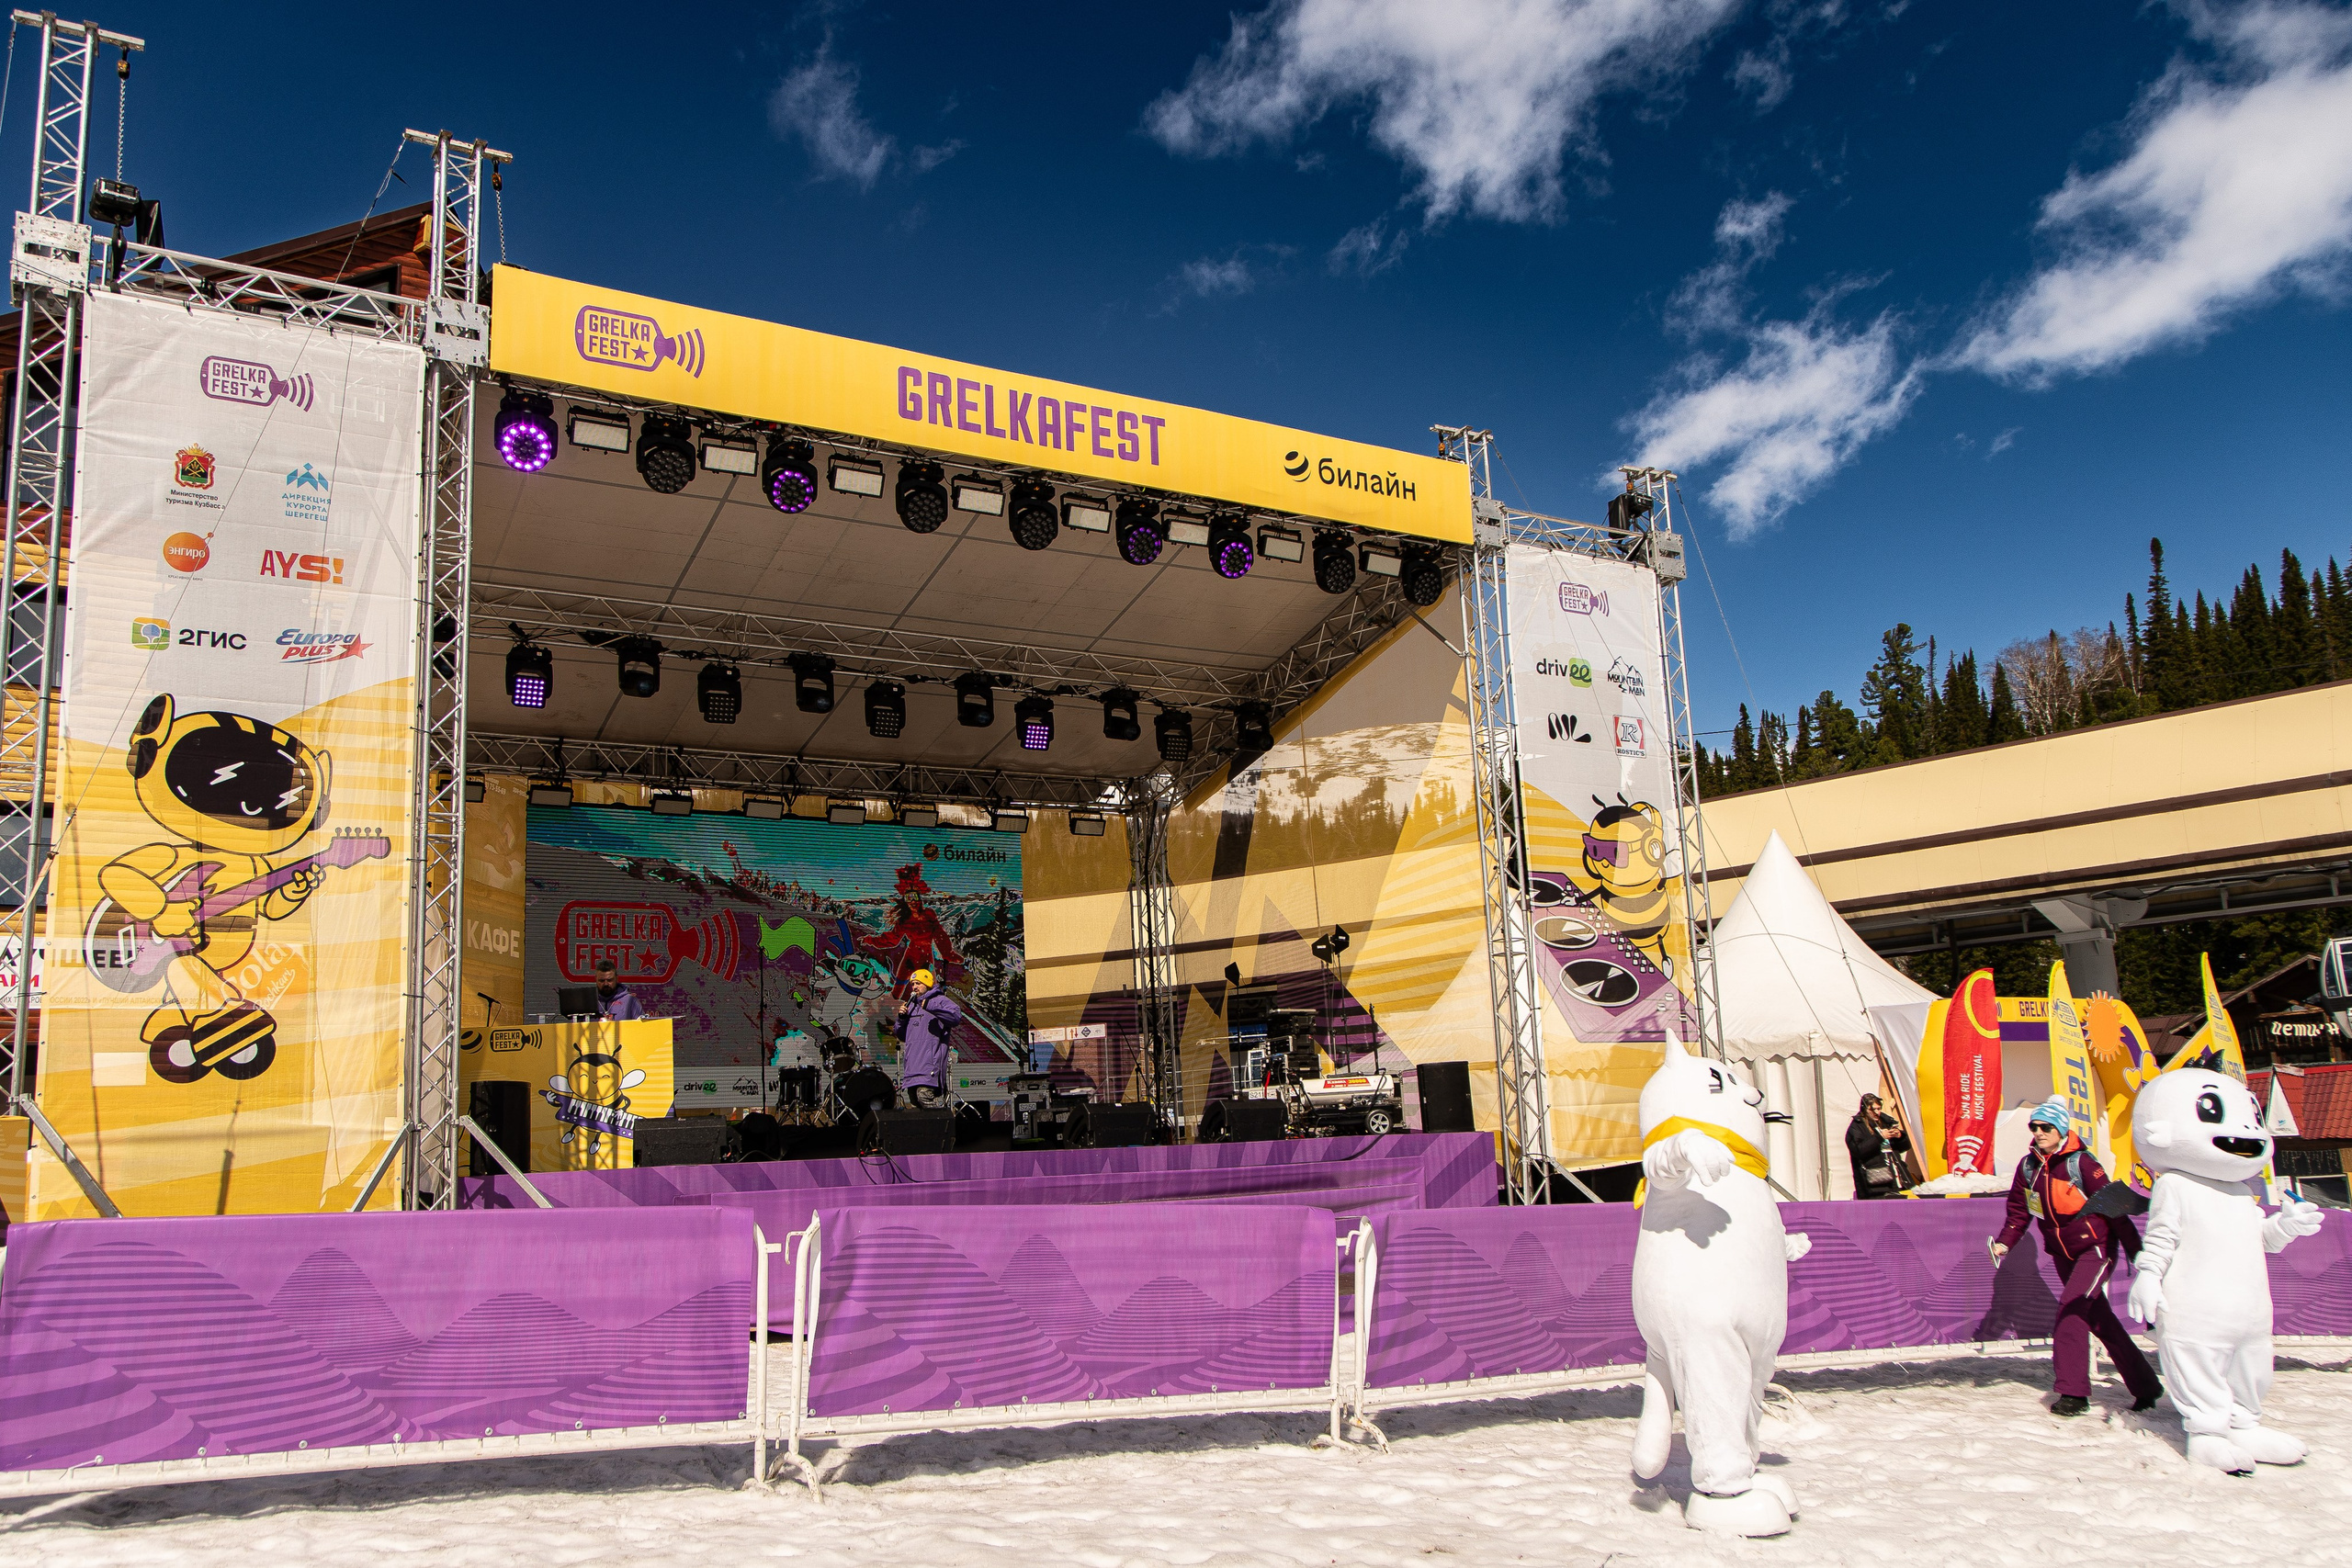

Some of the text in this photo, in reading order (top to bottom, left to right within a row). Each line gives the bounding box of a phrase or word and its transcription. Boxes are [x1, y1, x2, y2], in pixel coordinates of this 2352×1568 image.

[589, 313, 650, 343] GRELKA
[588, 334, 630, 359] FEST
[212, 362, 266, 384] GRELKA
[212, 378, 249, 397] FEST
[897, 366, 1166, 466] GRELKAFEST
[1317, 456, 1417, 502] билайн
[165, 497, 226, 510] туризма Кузбасса
[170, 489, 219, 501] Министерство
[281, 492, 332, 504] ДИРЕКЦИЯ
[285, 510, 328, 521] ШЕРЕГЕШ
[286, 502, 327, 513] КУРОРТА
[168, 546, 206, 559] энгиро
[260, 549, 345, 584] AYS!
[1564, 586, 1589, 600] GRELKA
[1564, 597, 1581, 610] FEST
[178, 628, 247, 650] 2ГИС
[1536, 658, 1592, 683] drivee
[944, 843, 1007, 864] билайн
[575, 912, 663, 942] GRELKA
[467, 919, 521, 958] КАФЕ
[575, 942, 635, 972] FEST
[494, 1032, 521, 1040] GRELKA
[494, 1040, 513, 1049] FEST
[684, 1081, 718, 1093] drivee
[1960, 1073, 1971, 1120] SUN & RIDE
[1973, 1054, 1984, 1121] MUSIC FESTIVAL
